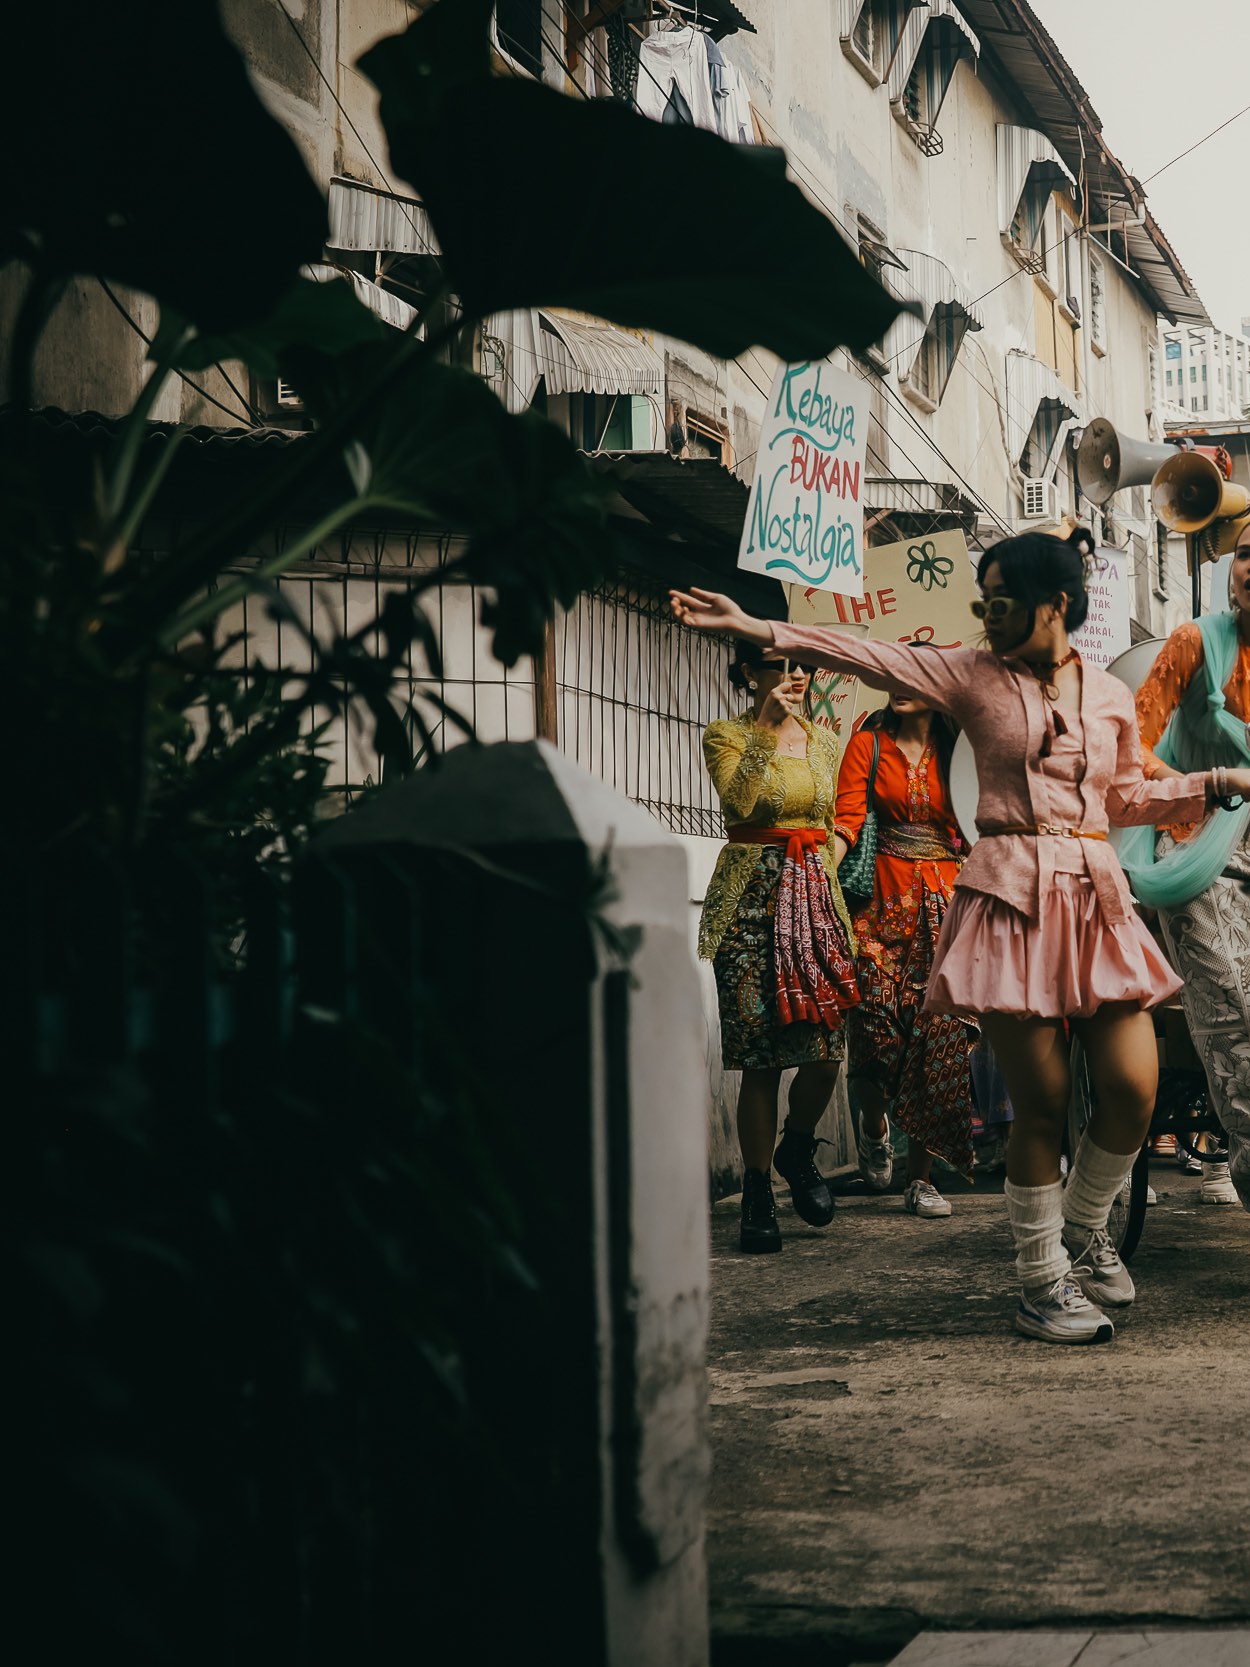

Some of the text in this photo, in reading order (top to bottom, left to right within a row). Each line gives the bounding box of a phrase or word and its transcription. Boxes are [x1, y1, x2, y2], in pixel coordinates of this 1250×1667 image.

[769, 360, 856, 451] Kebaya
[789, 434, 860, 502] BUKAN
[746, 464, 861, 585] Nostalgia
[1093, 599, 1111, 609] TAK
[1083, 625, 1114, 638] PAKAI,
[1075, 638, 1102, 649] MAKA
[810, 691, 848, 705] NGAN IKUT
[817, 715, 842, 732] ANG
